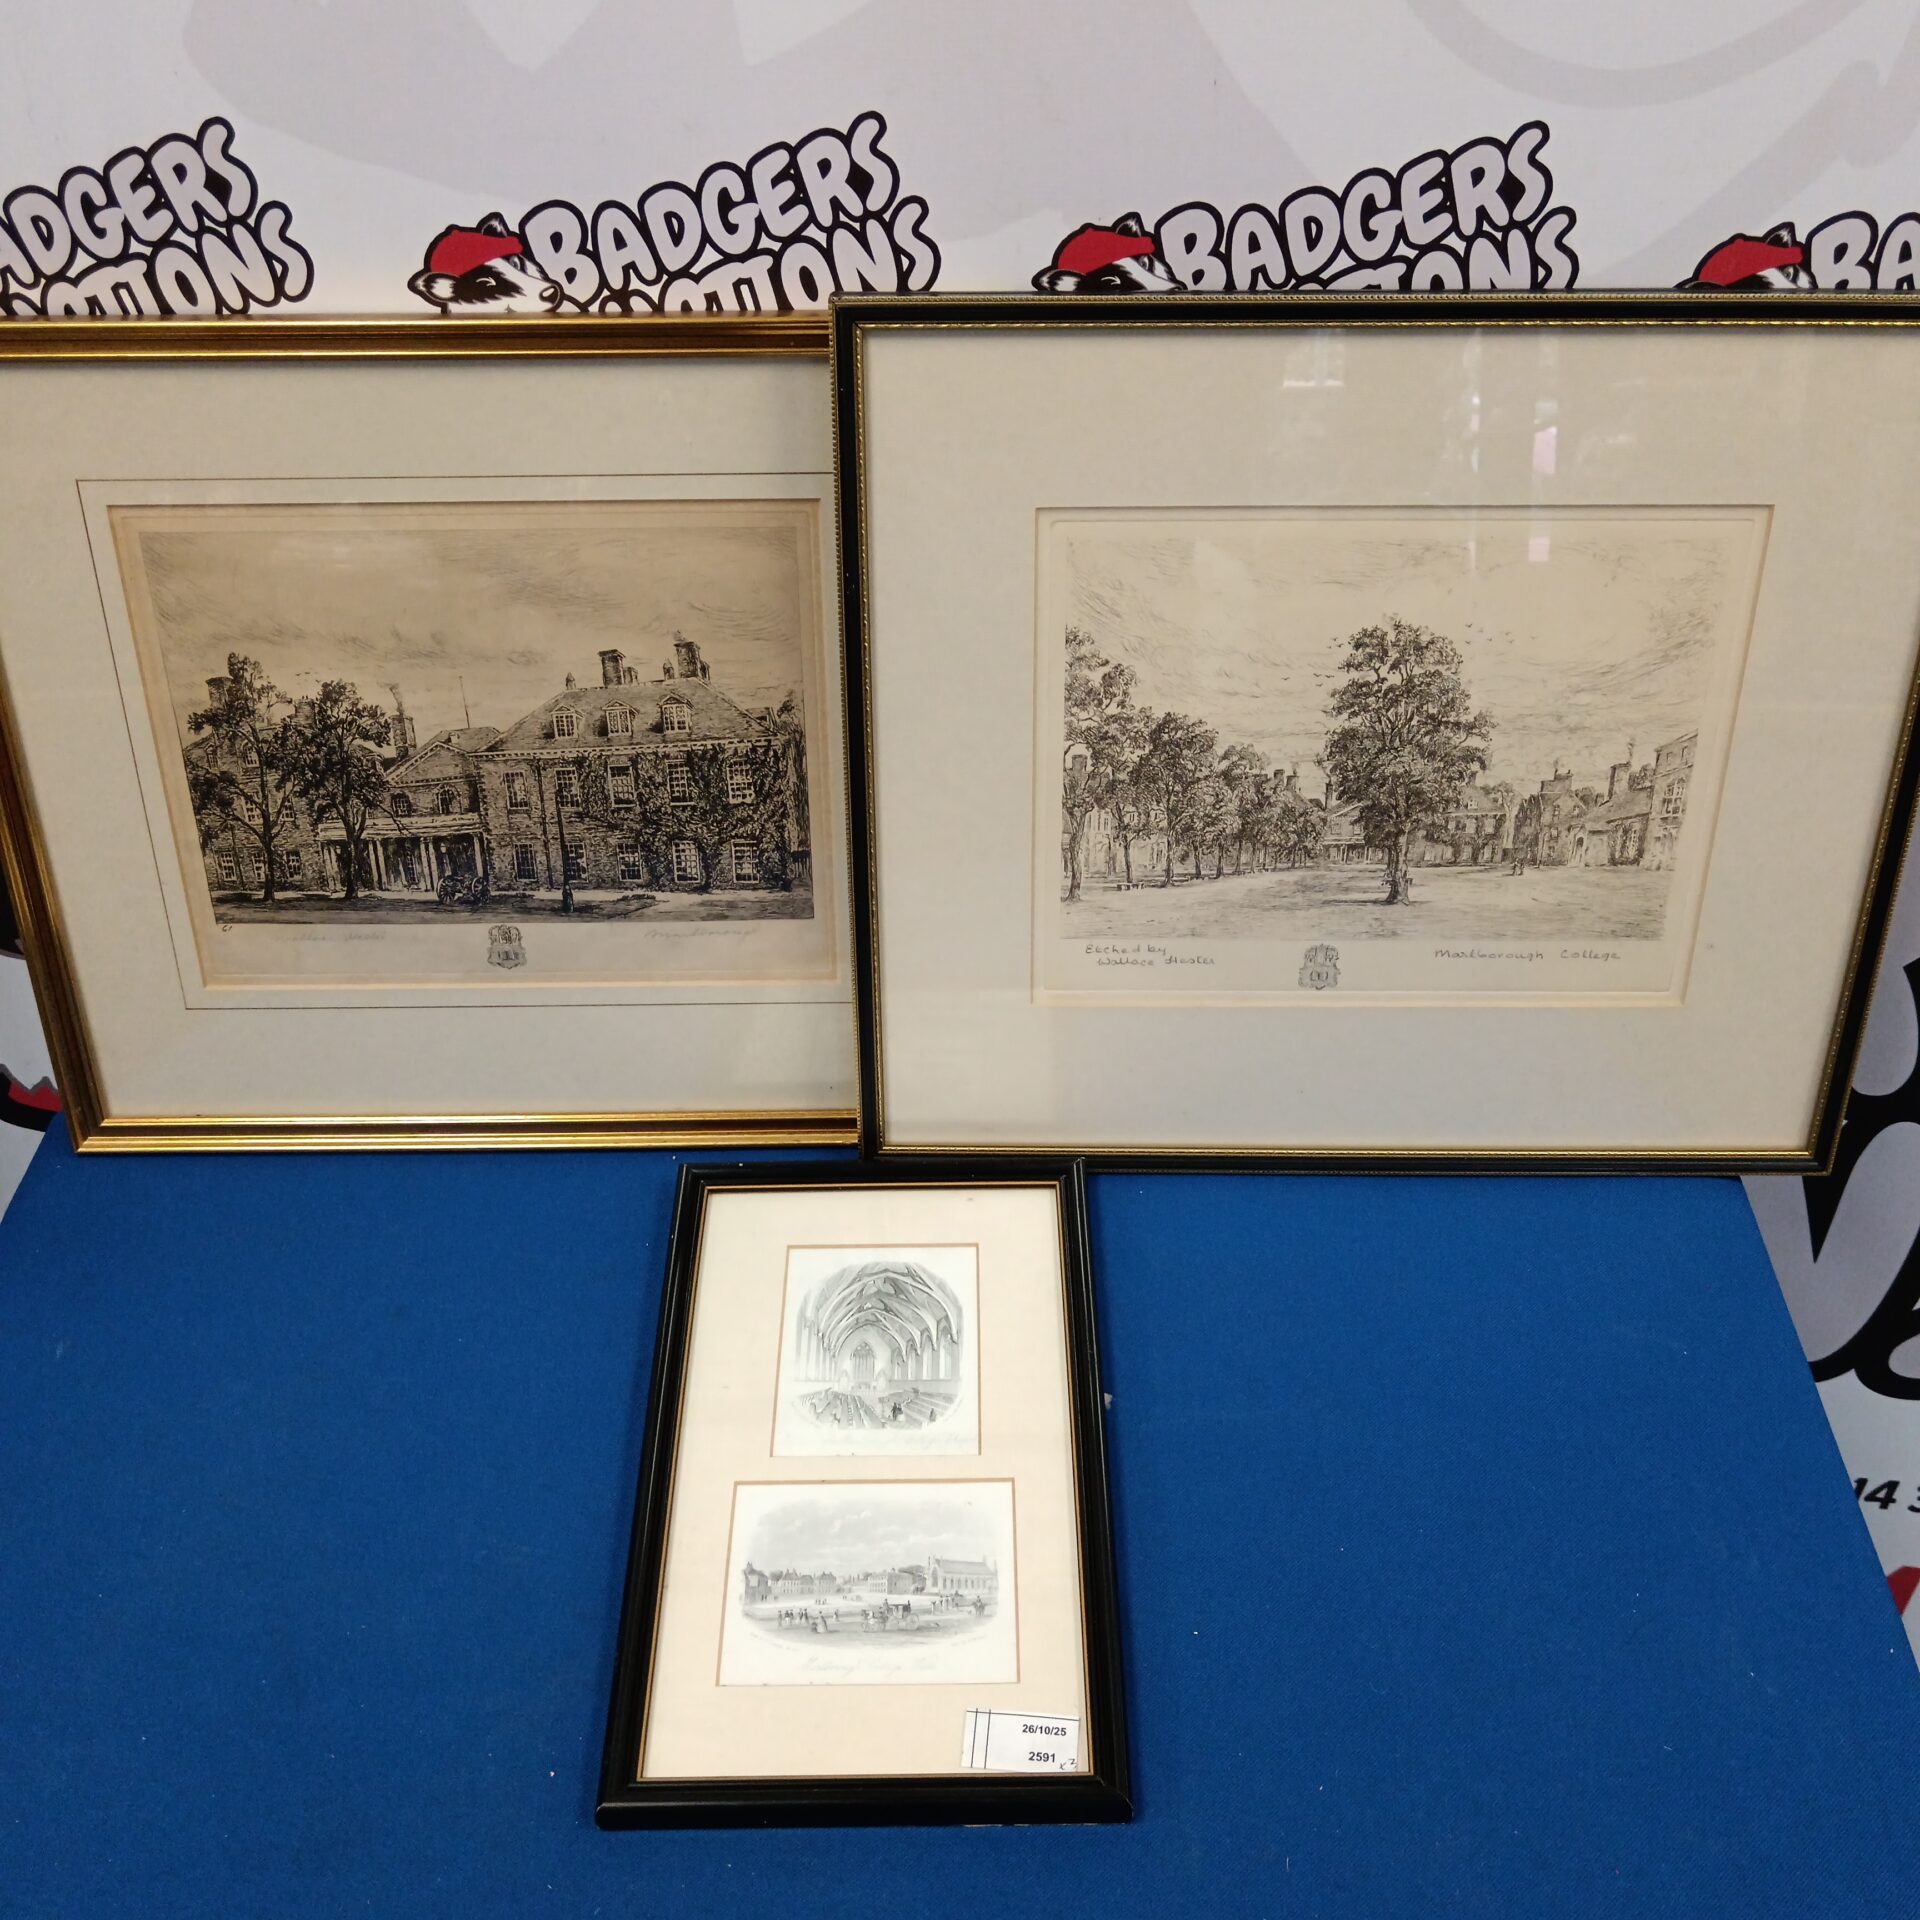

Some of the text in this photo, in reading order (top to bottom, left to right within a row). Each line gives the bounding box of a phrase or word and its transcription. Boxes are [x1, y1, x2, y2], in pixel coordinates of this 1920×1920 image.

[519, 110, 900, 308] BADGERS
[1154, 120, 1554, 291] BADGERS
[1147, 944, 1167, 957] by
[1434, 948, 1622, 962] Marlborough College
[1022, 1723, 1067, 1737] 26/10/25
[1028, 1751, 1056, 1763] 2591
